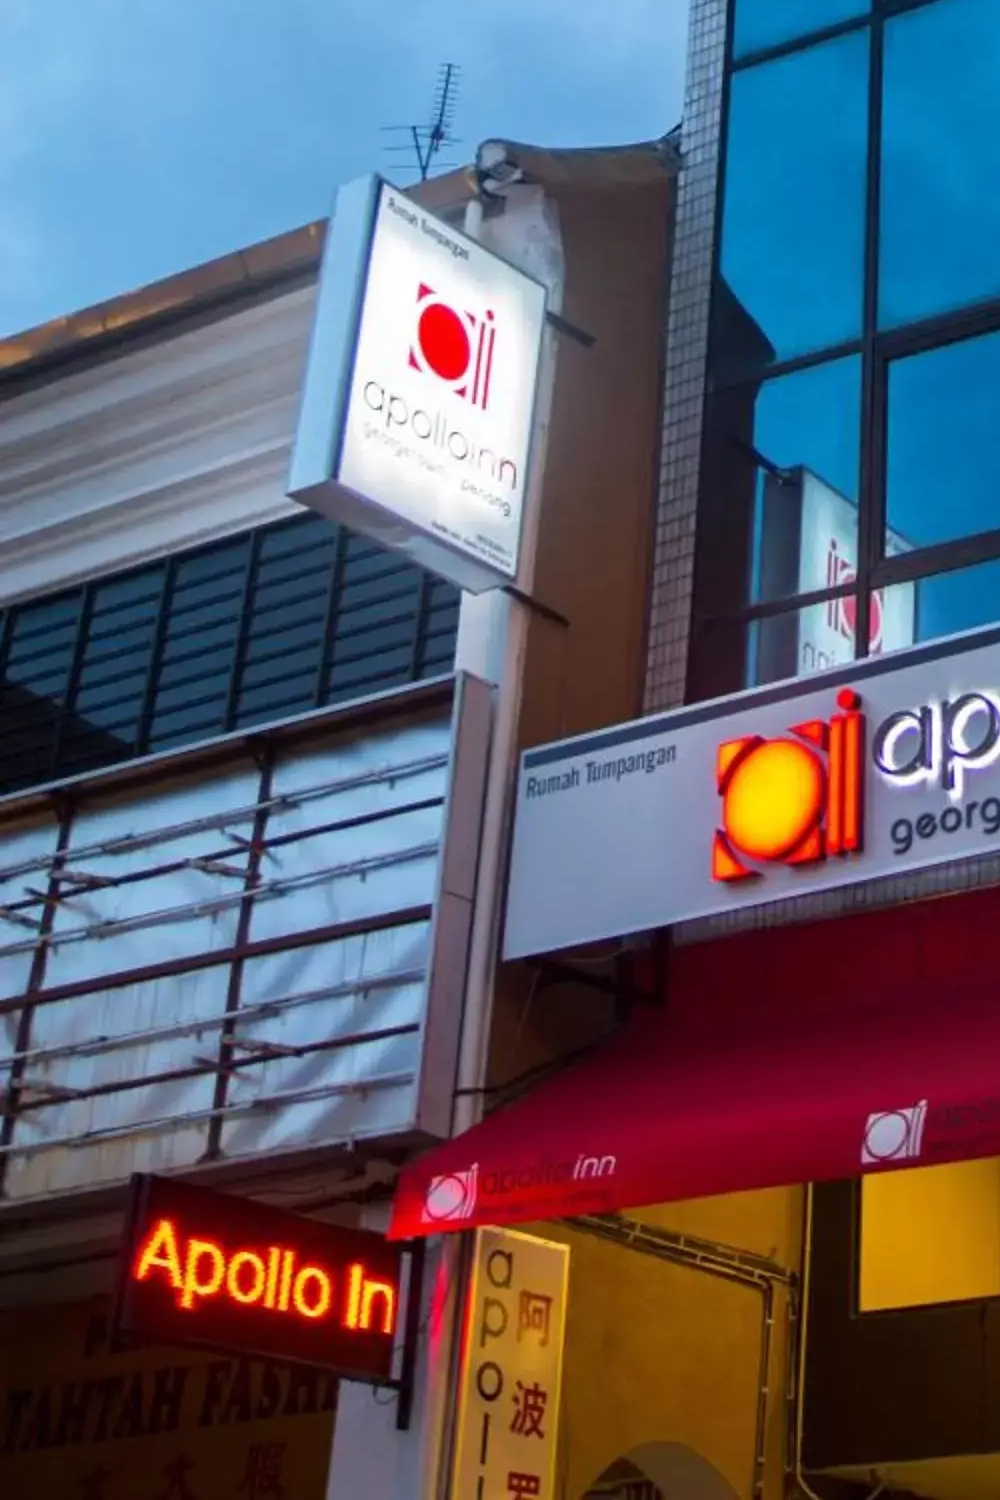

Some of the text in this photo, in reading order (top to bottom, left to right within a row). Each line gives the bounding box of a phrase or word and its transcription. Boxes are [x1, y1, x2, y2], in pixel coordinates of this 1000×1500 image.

[525, 744, 677, 799] Rumah Tumpangan
[132, 1219, 394, 1334] Apollo In
